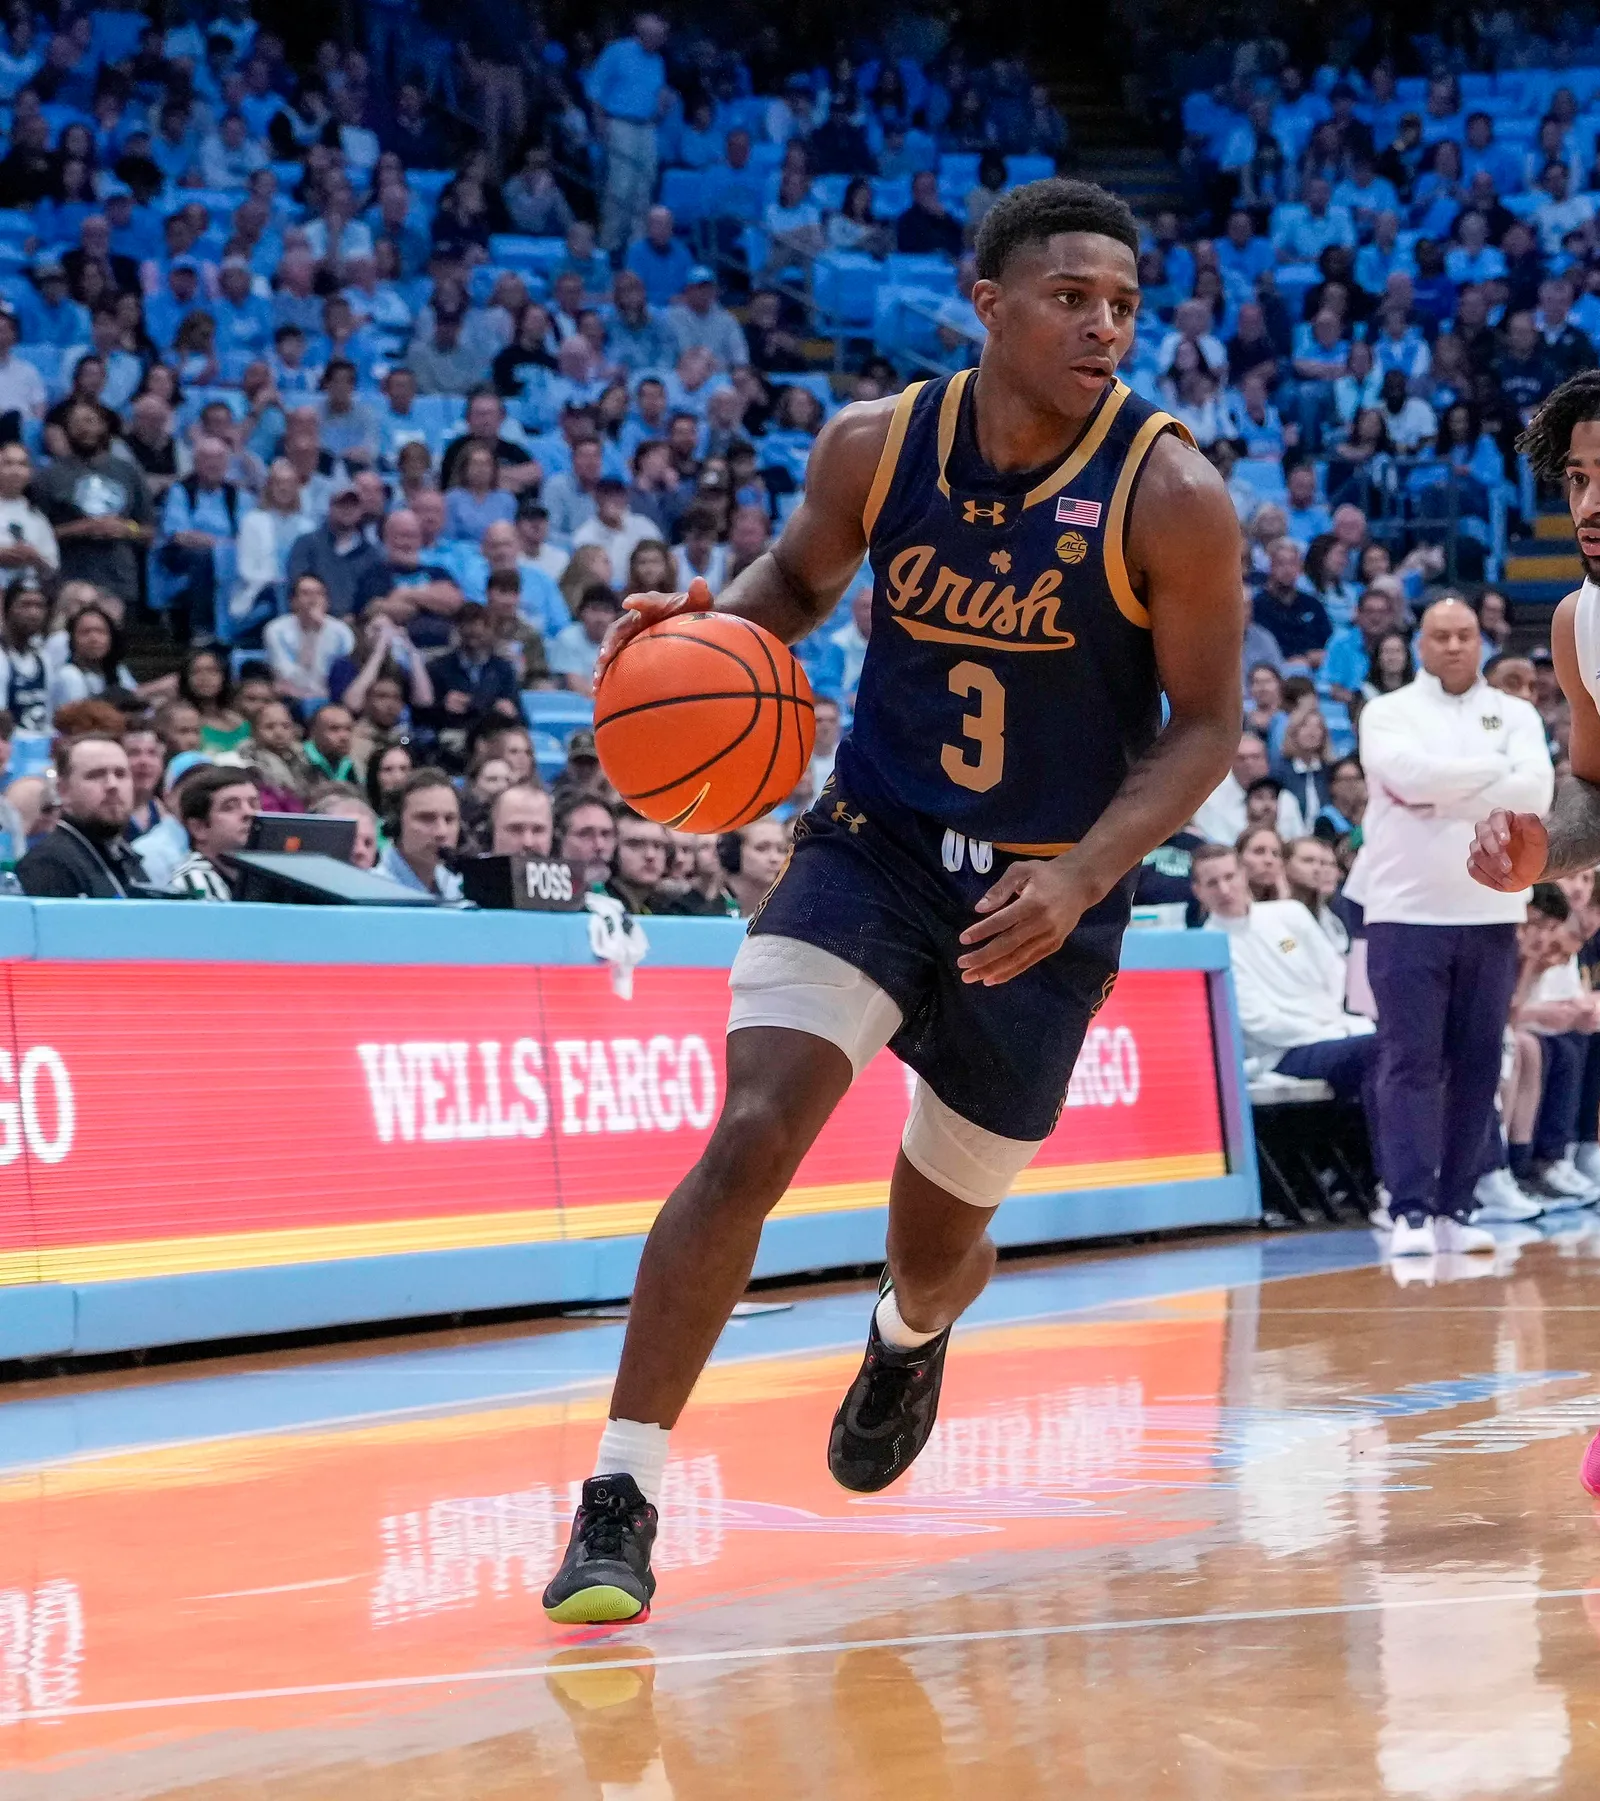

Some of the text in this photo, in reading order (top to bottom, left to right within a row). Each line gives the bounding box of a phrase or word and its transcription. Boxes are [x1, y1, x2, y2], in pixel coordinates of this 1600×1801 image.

[886, 545, 1076, 651] Irish
[940, 660, 1006, 794] 3
[525, 861, 574, 901] POSS
[355, 1033, 716, 1143] WELLS FARGO
